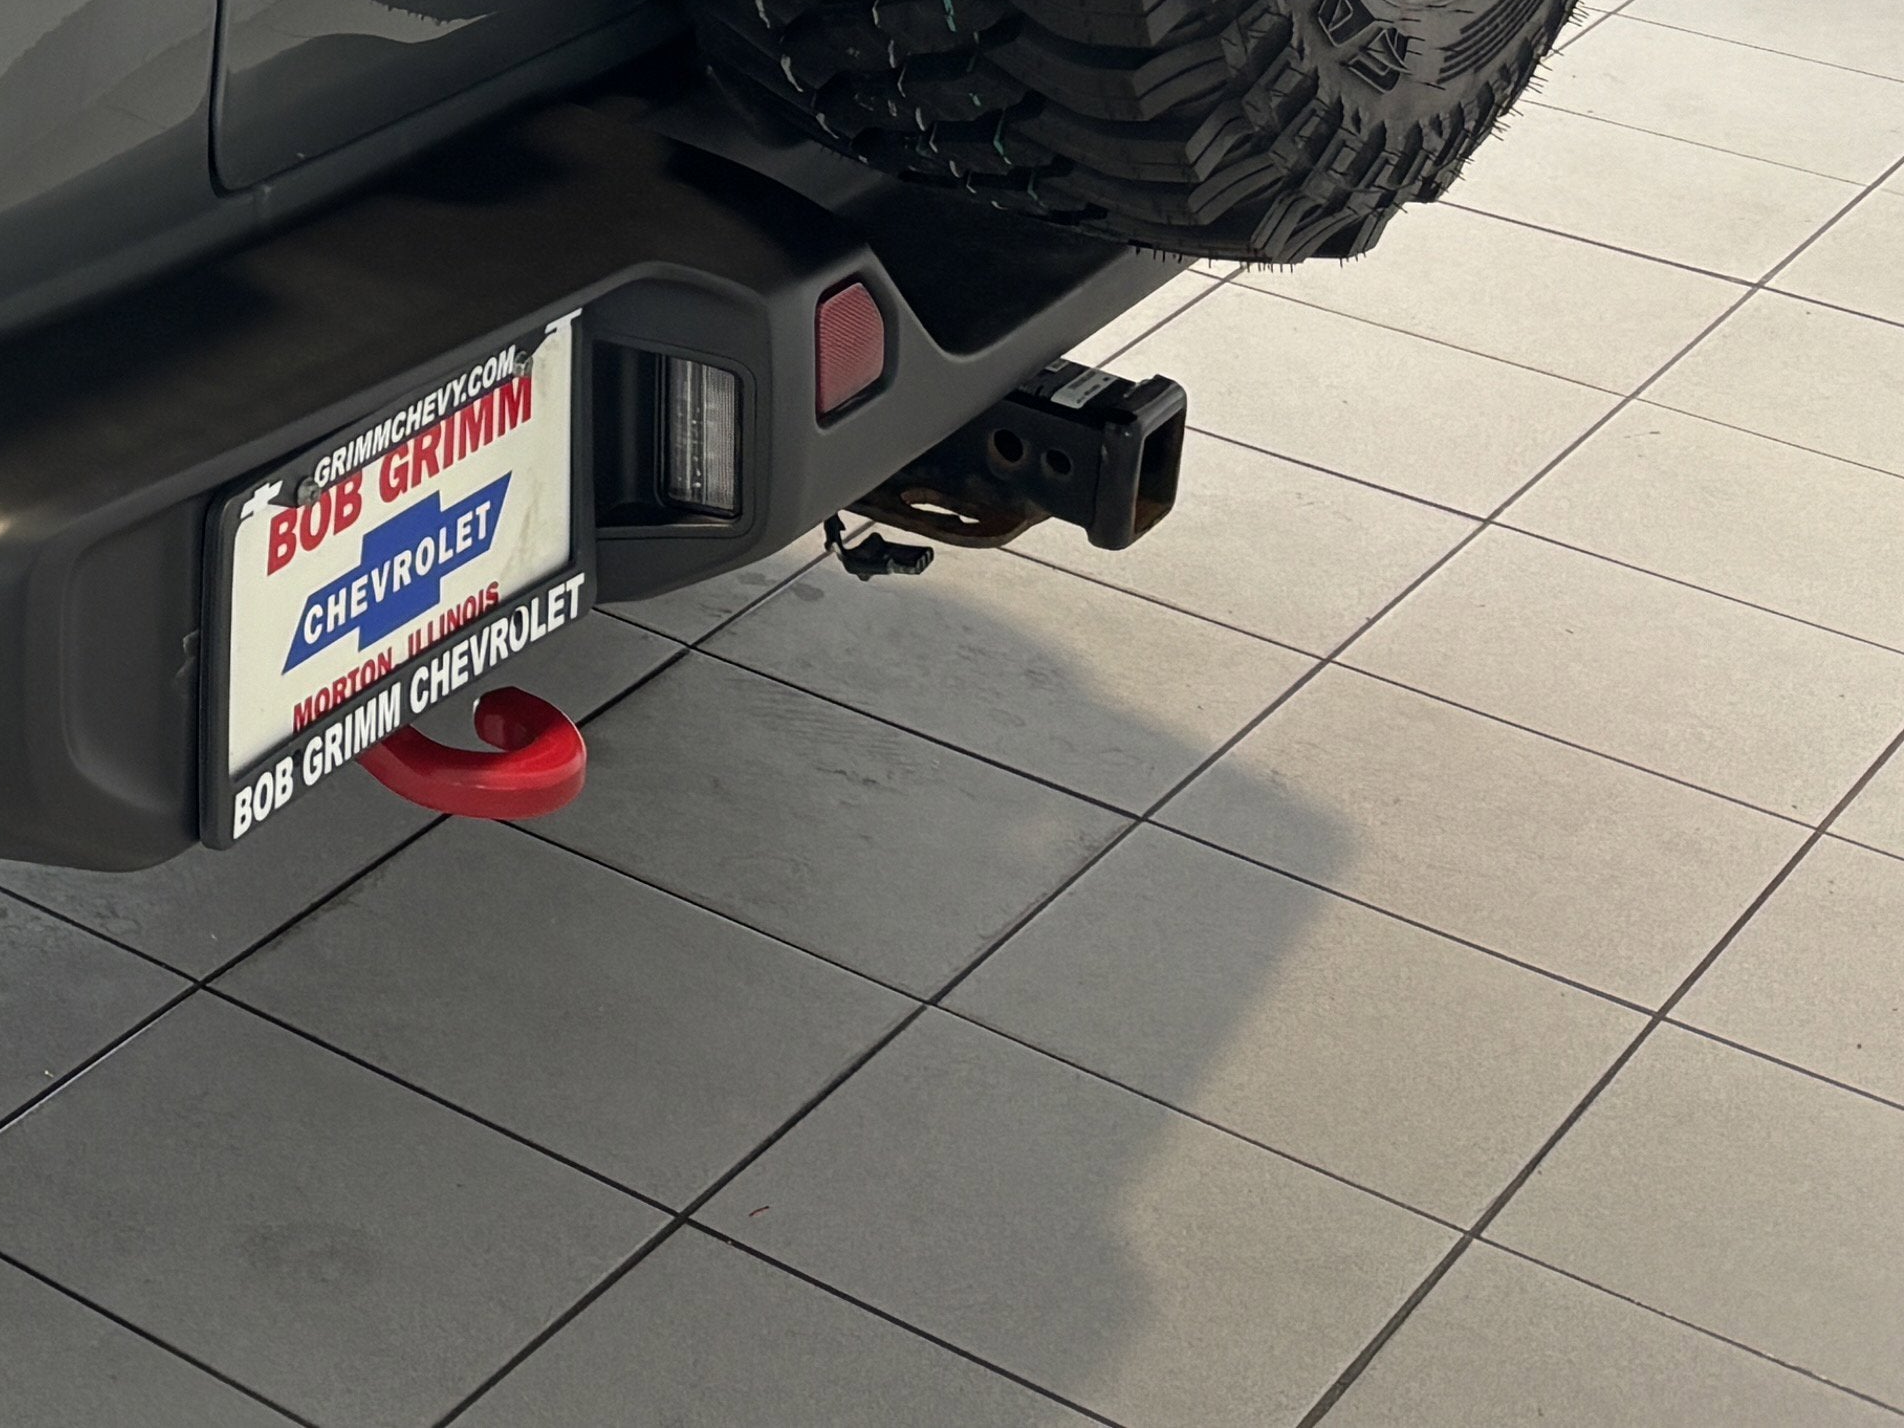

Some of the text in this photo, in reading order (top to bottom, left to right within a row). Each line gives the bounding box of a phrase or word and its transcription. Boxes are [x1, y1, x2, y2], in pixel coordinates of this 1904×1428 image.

[267, 375, 532, 576] BOB GRIMM
[313, 345, 517, 484] GRIMMCHEVY.COM
[303, 500, 492, 645] CHEVROLET
[408, 581, 500, 660] ILLINOIS
[233, 573, 586, 840] BOB GRIMM CHEVROLET
